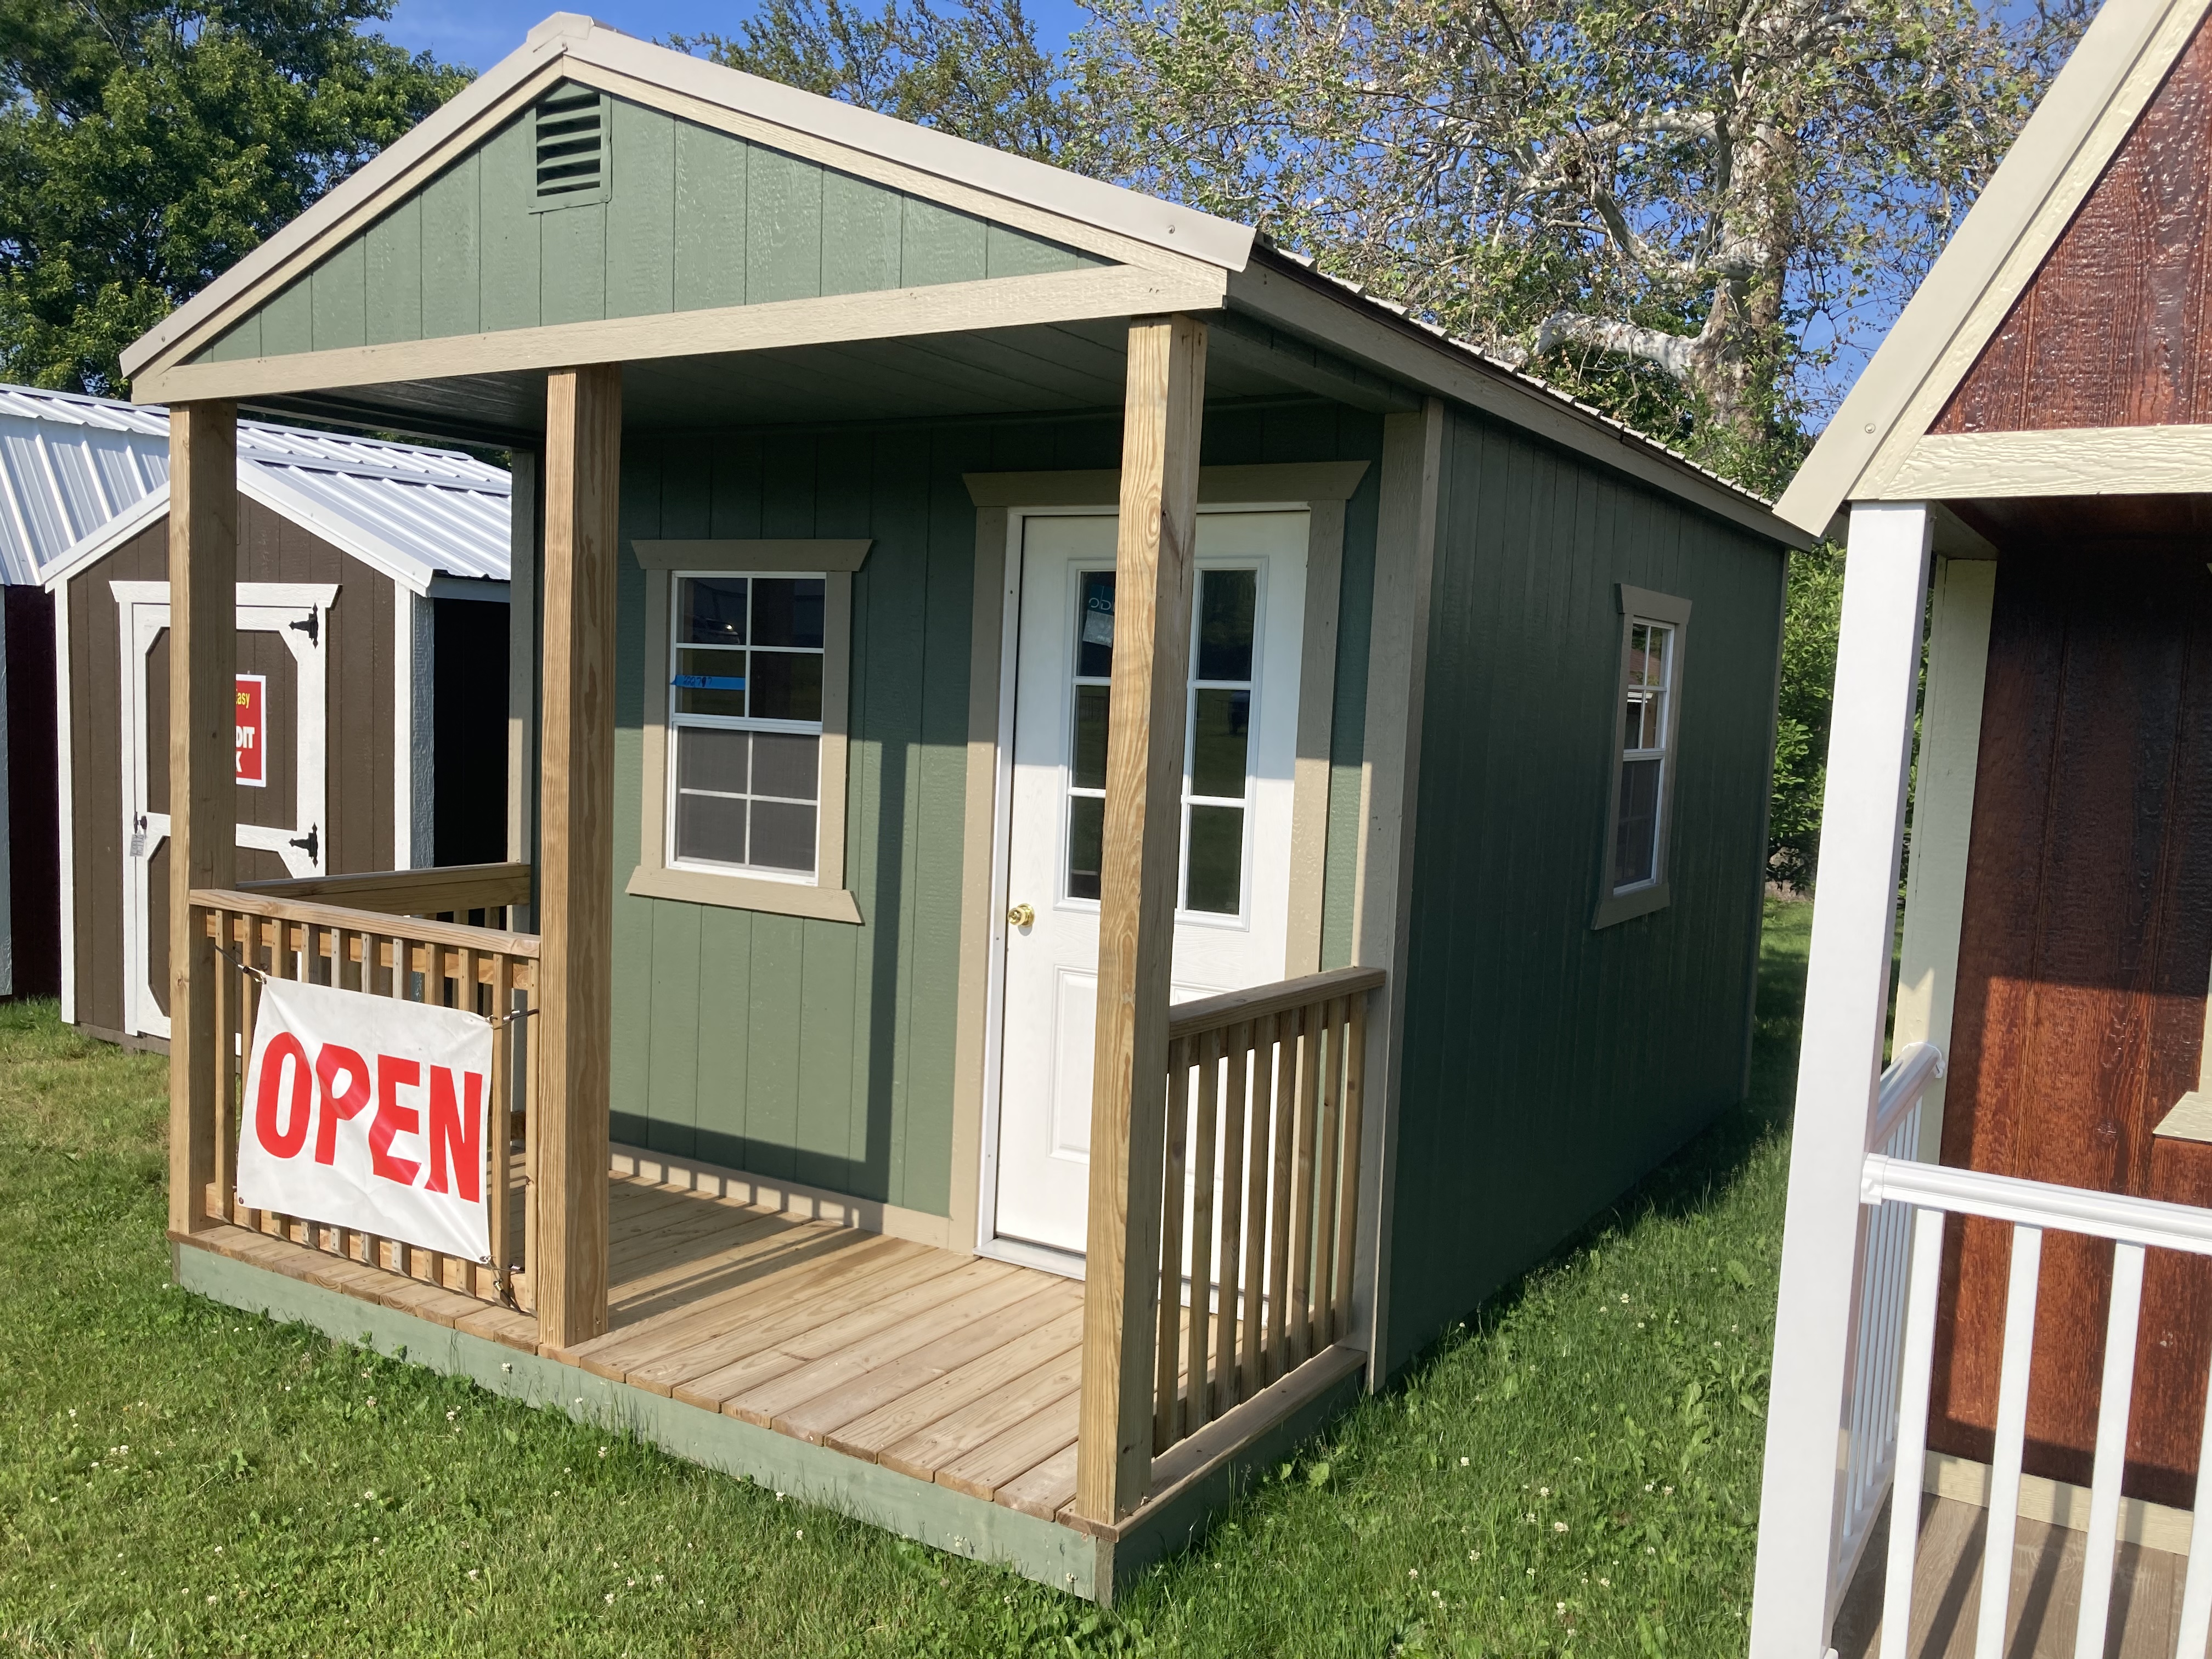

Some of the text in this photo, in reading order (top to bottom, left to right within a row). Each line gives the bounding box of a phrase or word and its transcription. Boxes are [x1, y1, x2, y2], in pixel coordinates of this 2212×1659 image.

[1088, 597, 1114, 612] OD
[236, 689, 250, 709] asy
[255, 1031, 483, 1204] OPEN
